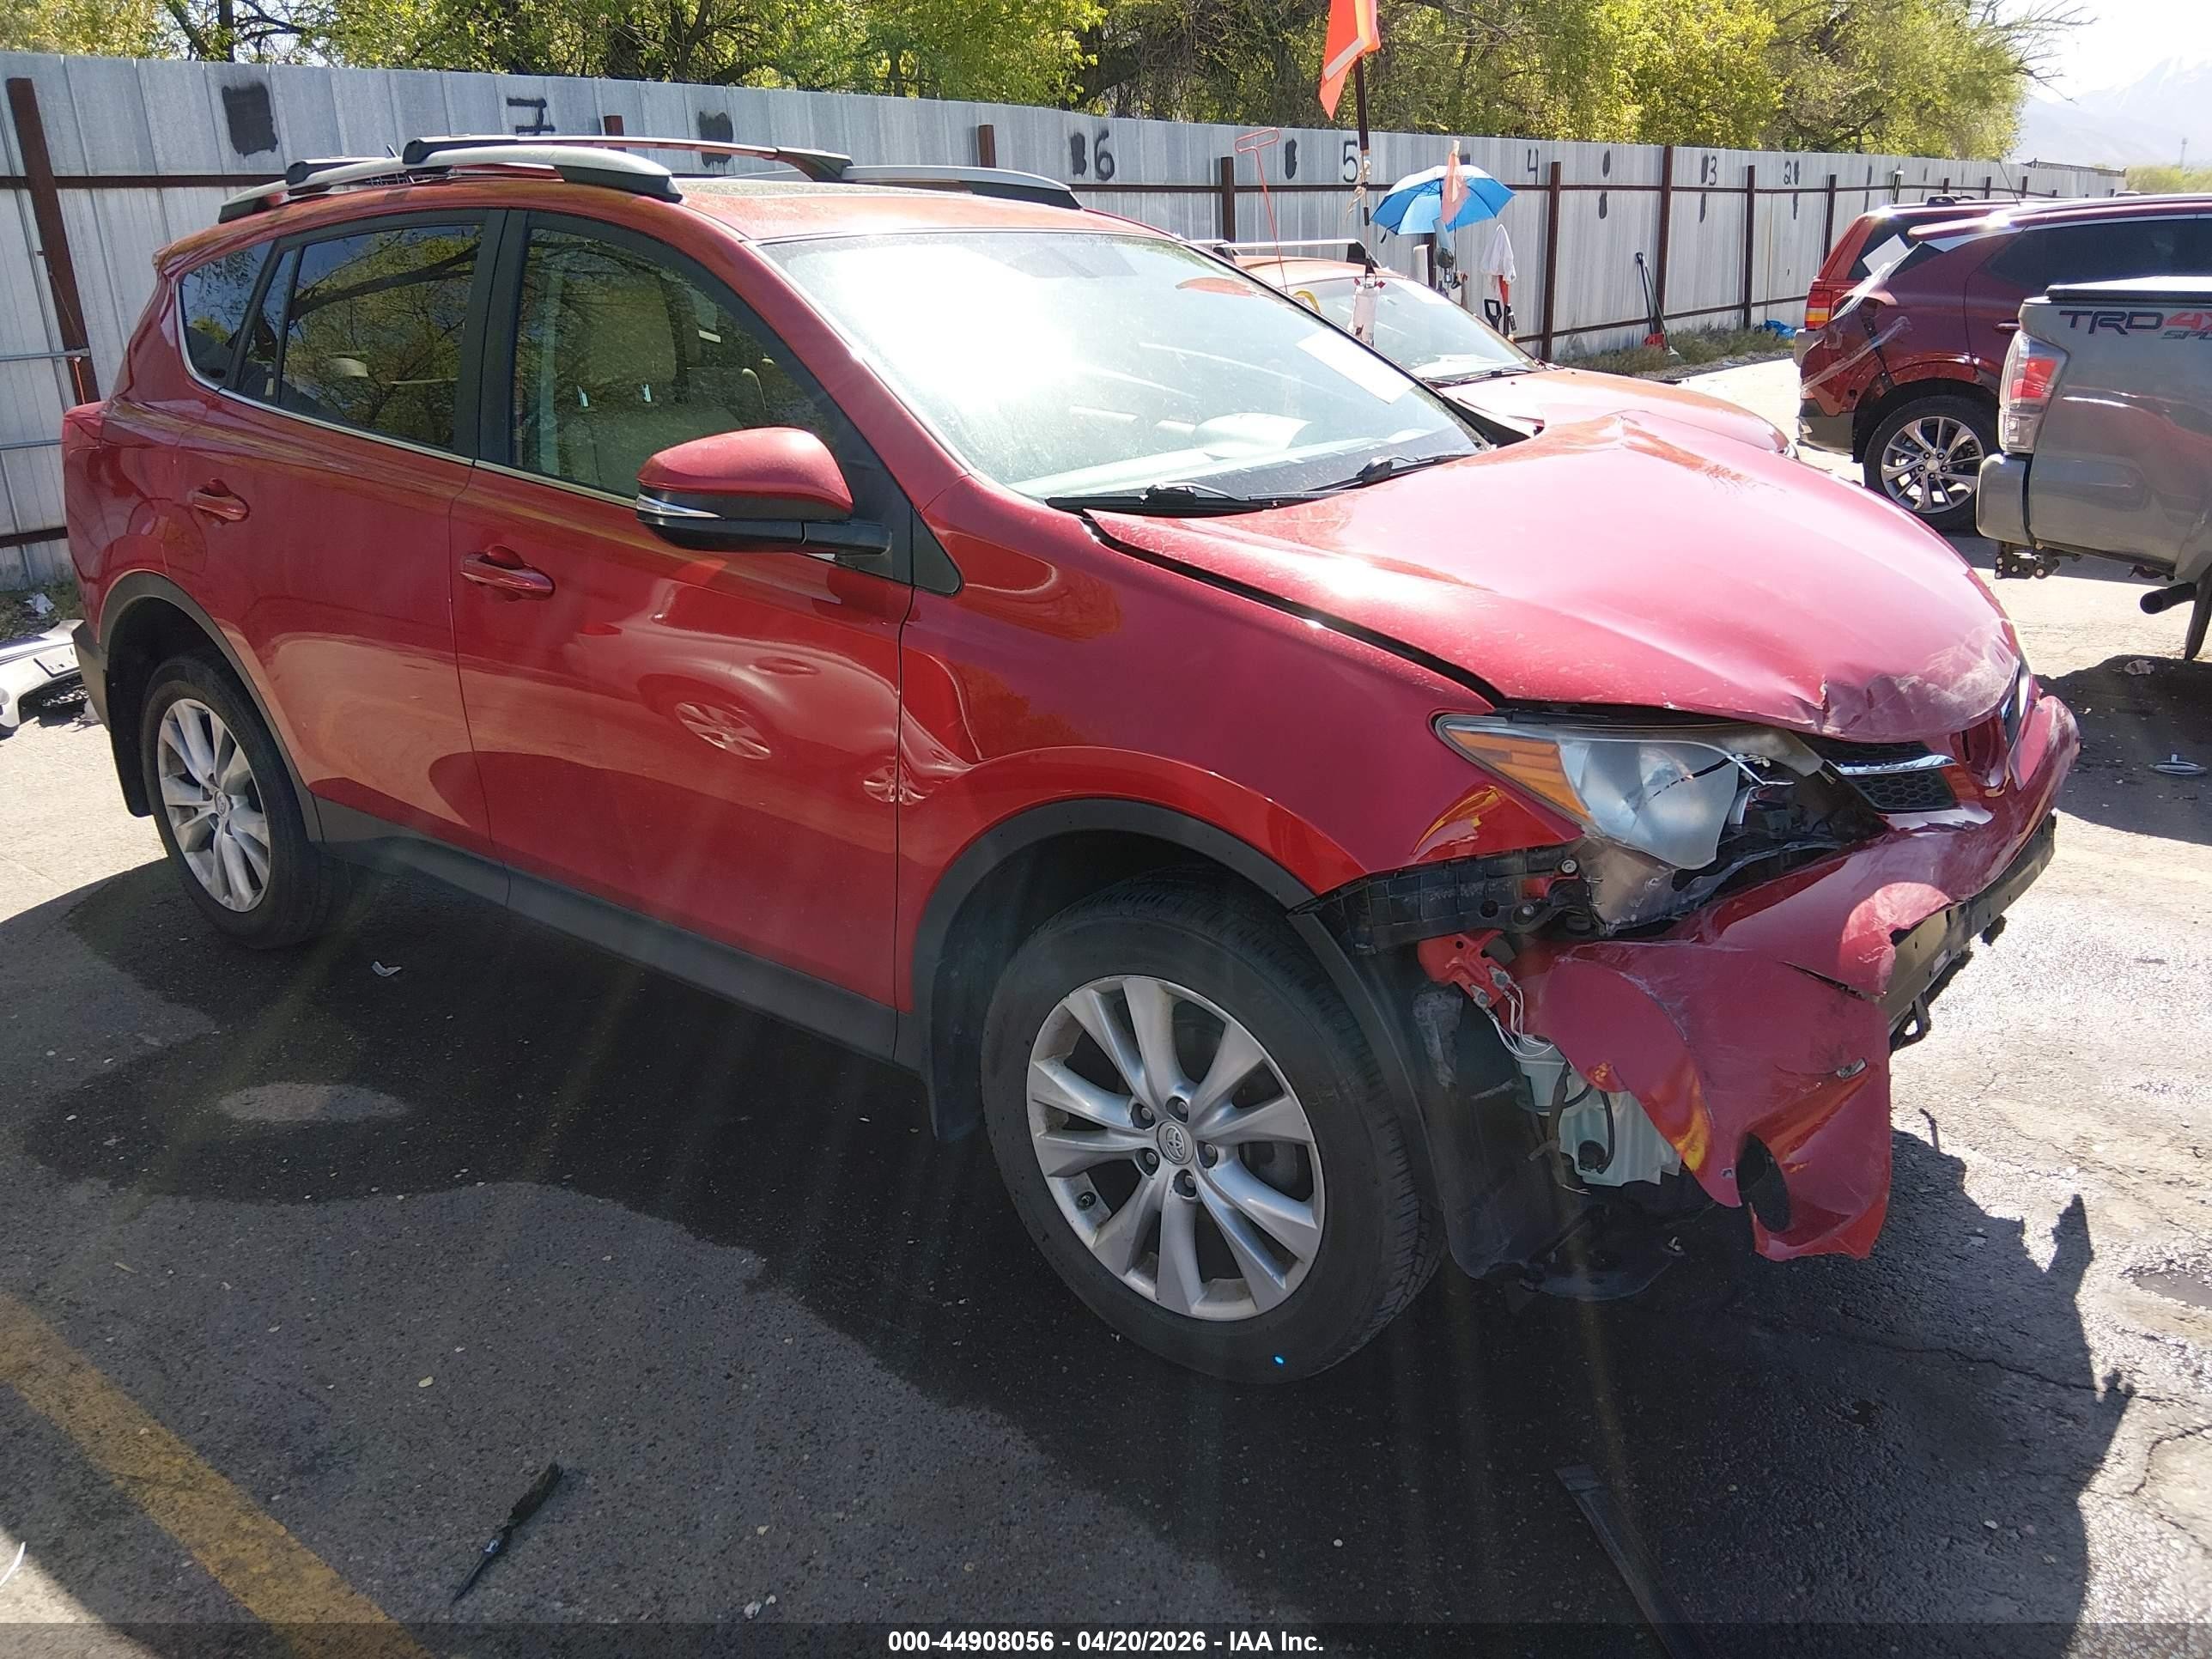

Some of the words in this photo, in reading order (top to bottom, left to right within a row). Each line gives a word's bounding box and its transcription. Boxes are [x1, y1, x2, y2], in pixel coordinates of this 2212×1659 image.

[1094, 129, 1115, 181] 6
[1342, 140, 1358, 183] 5
[1527, 149, 1539, 185] 4
[2059, 310, 2164, 335] TRD
